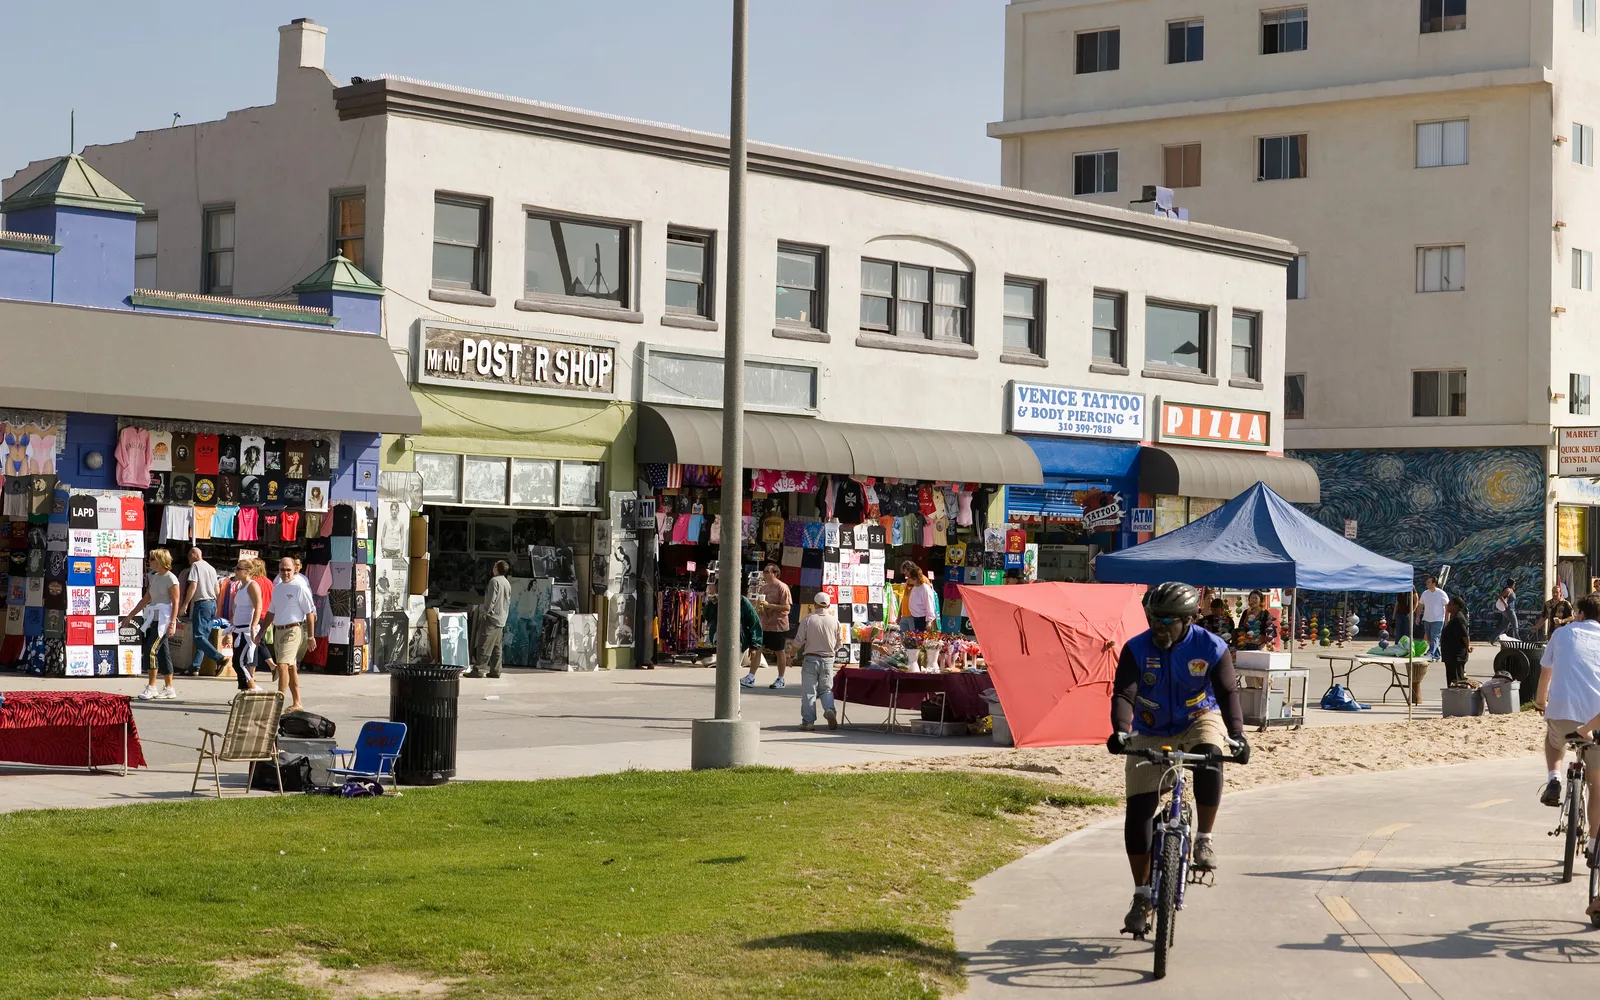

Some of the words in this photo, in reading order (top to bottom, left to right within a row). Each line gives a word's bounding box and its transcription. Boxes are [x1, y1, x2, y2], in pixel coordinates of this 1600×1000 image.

[427, 349, 442, 370] Mr
[445, 350, 460, 372] No
[554, 349, 612, 387] SHOP
[1018, 387, 1077, 406] VENICE
[1082, 391, 1140, 411] TATTOO
[1018, 406, 1028, 417] &
[1031, 407, 1064, 420] BODY
[1067, 410, 1125, 425] PIERCING
[1058, 422, 1073, 431] 310
[1075, 423, 1112, 434] 399-7818
[1167, 406, 1262, 441] PIZZA
[1560, 446, 1580, 454] QUICK
[72, 507, 94, 517] LAPD
[638, 501, 655, 518] ATM
[1086, 504, 1116, 520] TATTOO
[1133, 509, 1153, 522] ATM
[870, 534, 884, 543] FBI
[71, 588, 90, 597] HELP!
